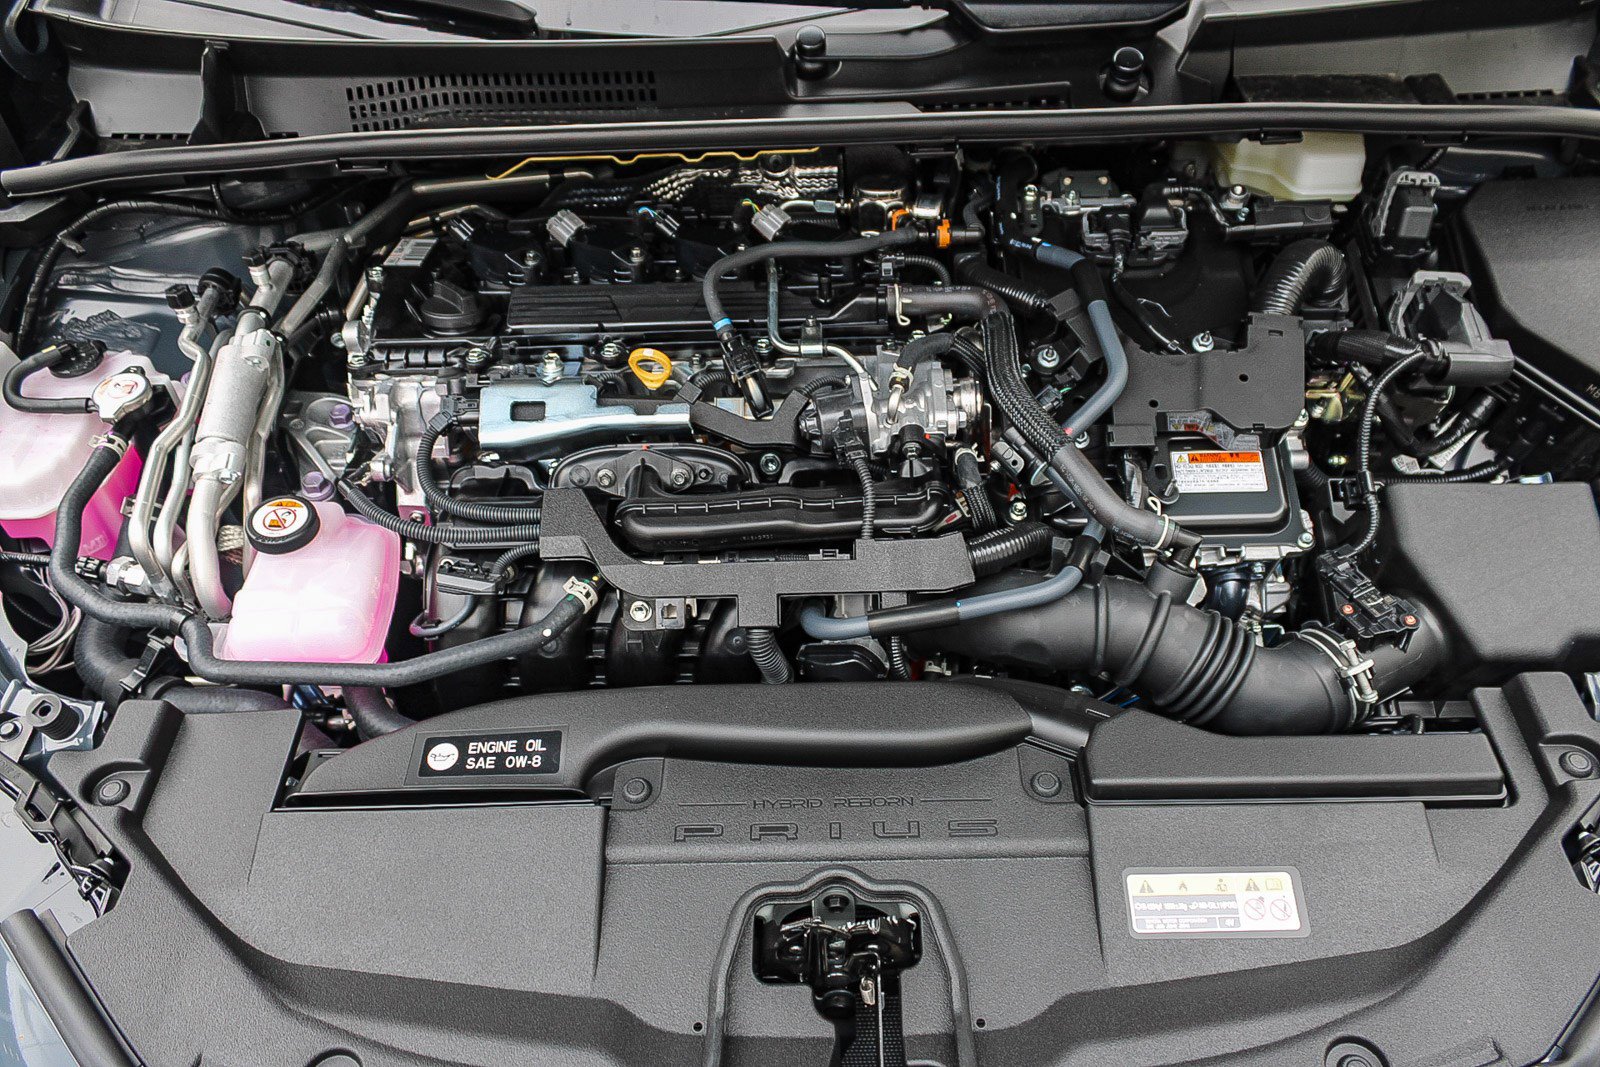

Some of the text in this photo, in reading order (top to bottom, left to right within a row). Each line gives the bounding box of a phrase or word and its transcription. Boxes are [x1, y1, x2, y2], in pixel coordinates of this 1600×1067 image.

[468, 739, 547, 754] ENGINE OIL
[465, 756, 496, 769] SAE
[753, 796, 914, 810] HYBRID REBORN
[674, 819, 998, 842] PRIUS
